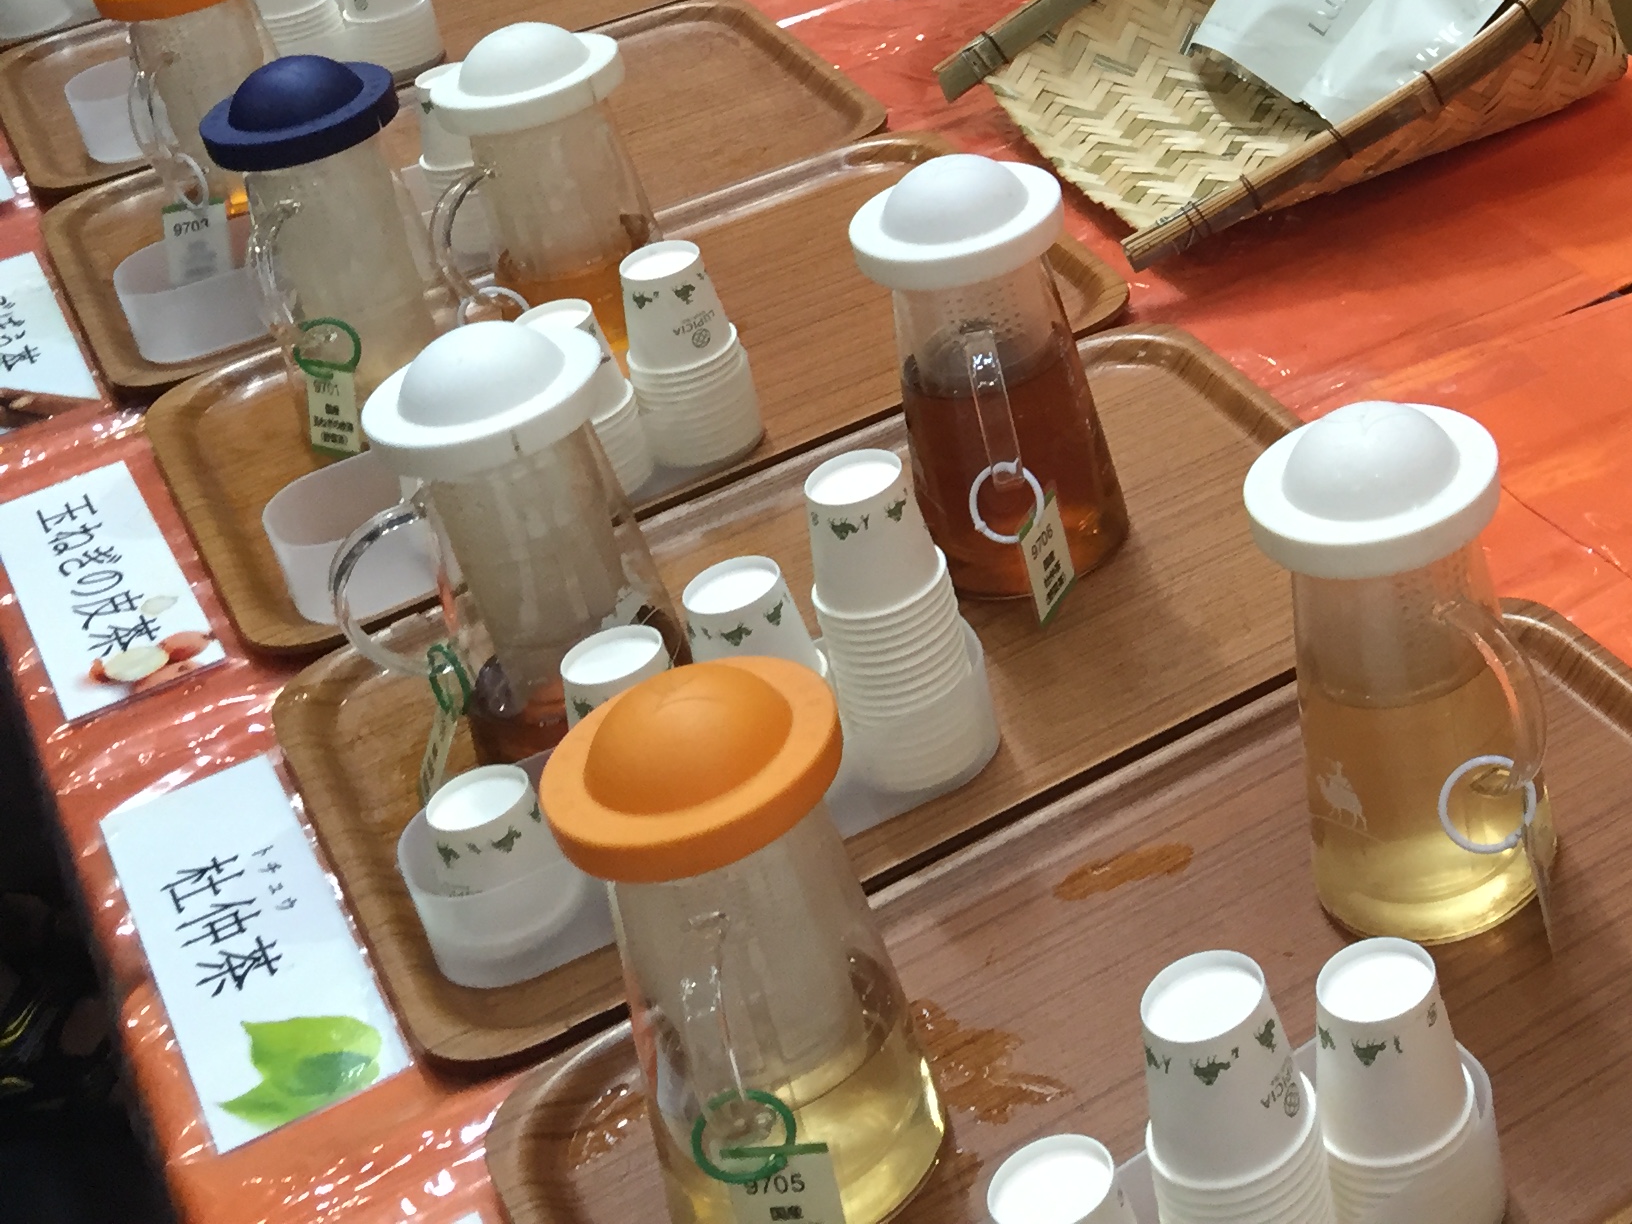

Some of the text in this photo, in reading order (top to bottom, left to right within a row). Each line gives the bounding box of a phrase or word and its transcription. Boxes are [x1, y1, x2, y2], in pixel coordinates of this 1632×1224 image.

[672, 309, 716, 336] LUPICIA
[36, 493, 161, 657] 玉ねぎの皮茶
[160, 854, 283, 998] 杜仲茶
[252, 845, 298, 912] トチュウ
